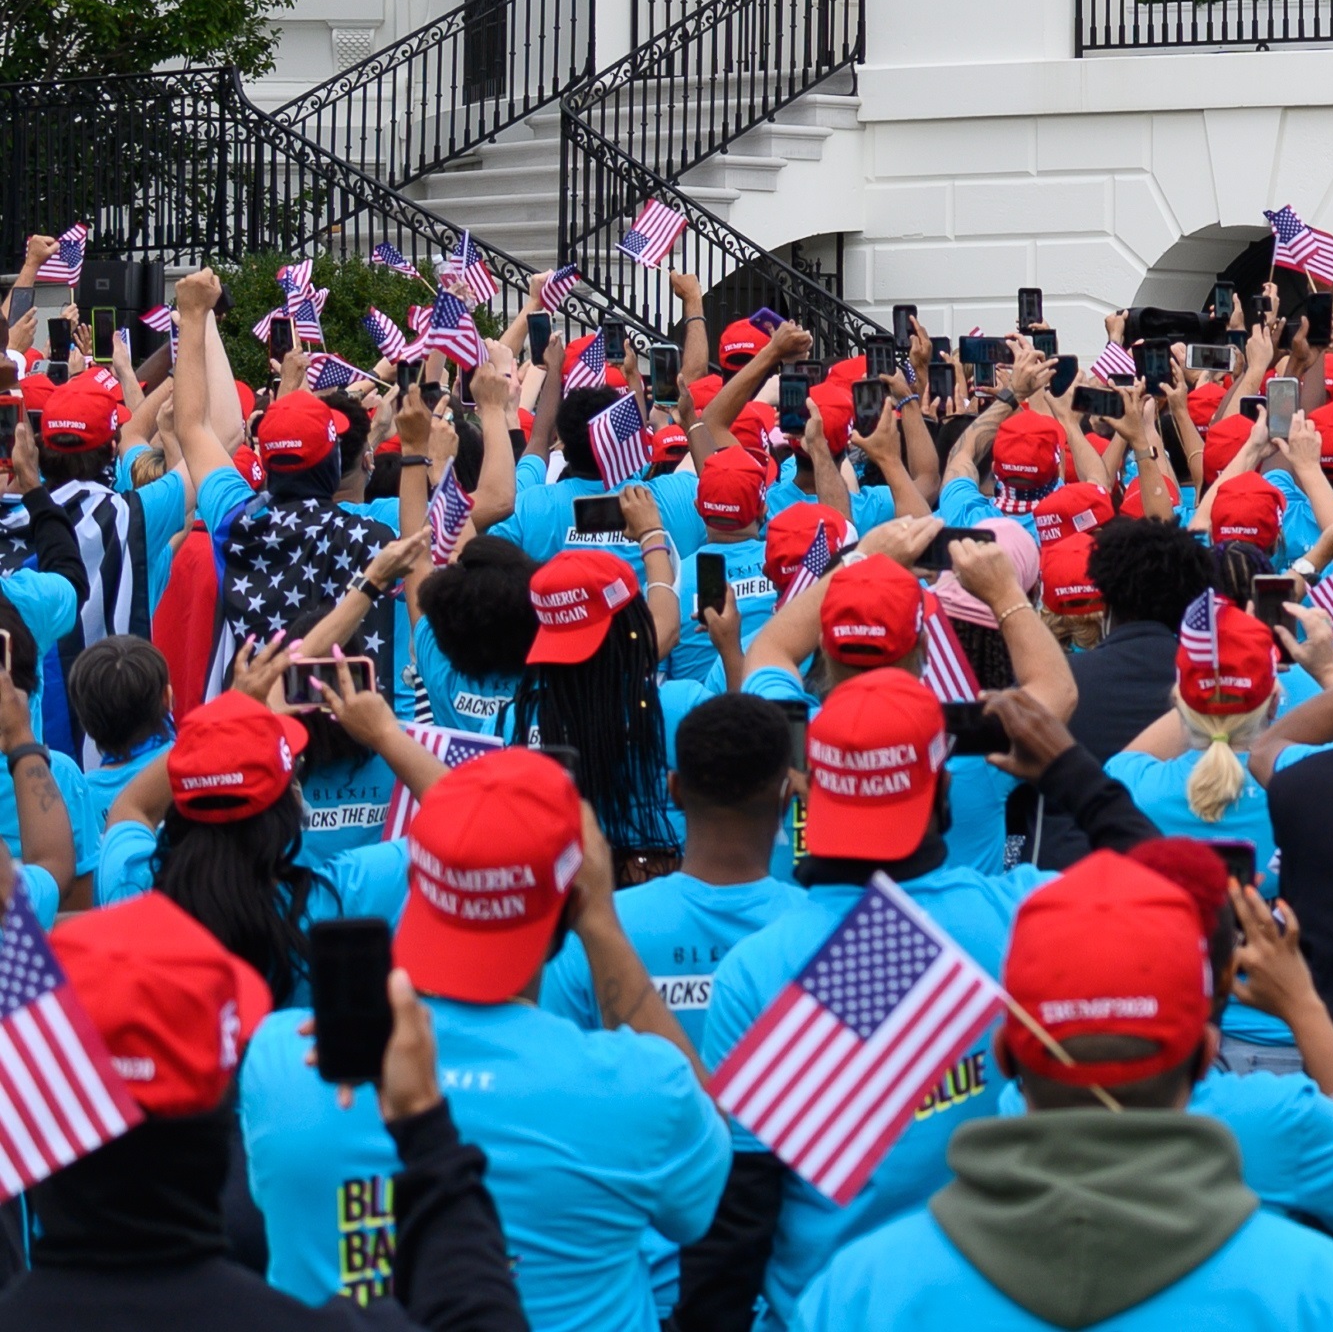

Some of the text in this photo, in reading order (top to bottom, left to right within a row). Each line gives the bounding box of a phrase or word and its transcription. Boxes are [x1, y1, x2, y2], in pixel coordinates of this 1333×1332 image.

[724, 341, 755, 352] TRUMP2020
[48, 419, 86, 431] TRUMP2020
[265, 440, 302, 451] TRUMP2020
[1001, 463, 1038, 474] TRUMP2020
[703, 501, 740, 513] TRUMP2020
[1037, 513, 1062, 528] ERICA
[568, 530, 604, 543] BACKS
[1220, 526, 1258, 535] TRUMP2020
[728, 561, 762, 577] EXIT
[736, 578, 776, 597] THE BL
[1055, 585, 1098, 596] TRUMP20
[556, 605, 588, 623] AGAIN
[833, 625, 886, 637] TRUMP2020
[456, 695, 496, 717] BACKS
[844, 744, 918, 770] AMERICA
[182, 773, 244, 790] TRUMP2020
[859, 770, 912, 796] AGAIN
[304, 805, 390, 828] CKS THE BLU
[444, 864, 537, 892] AMERICA
[459, 894, 526, 920] AGAIN
[673, 946, 722, 964] BLE
[663, 981, 710, 1003] CKS
